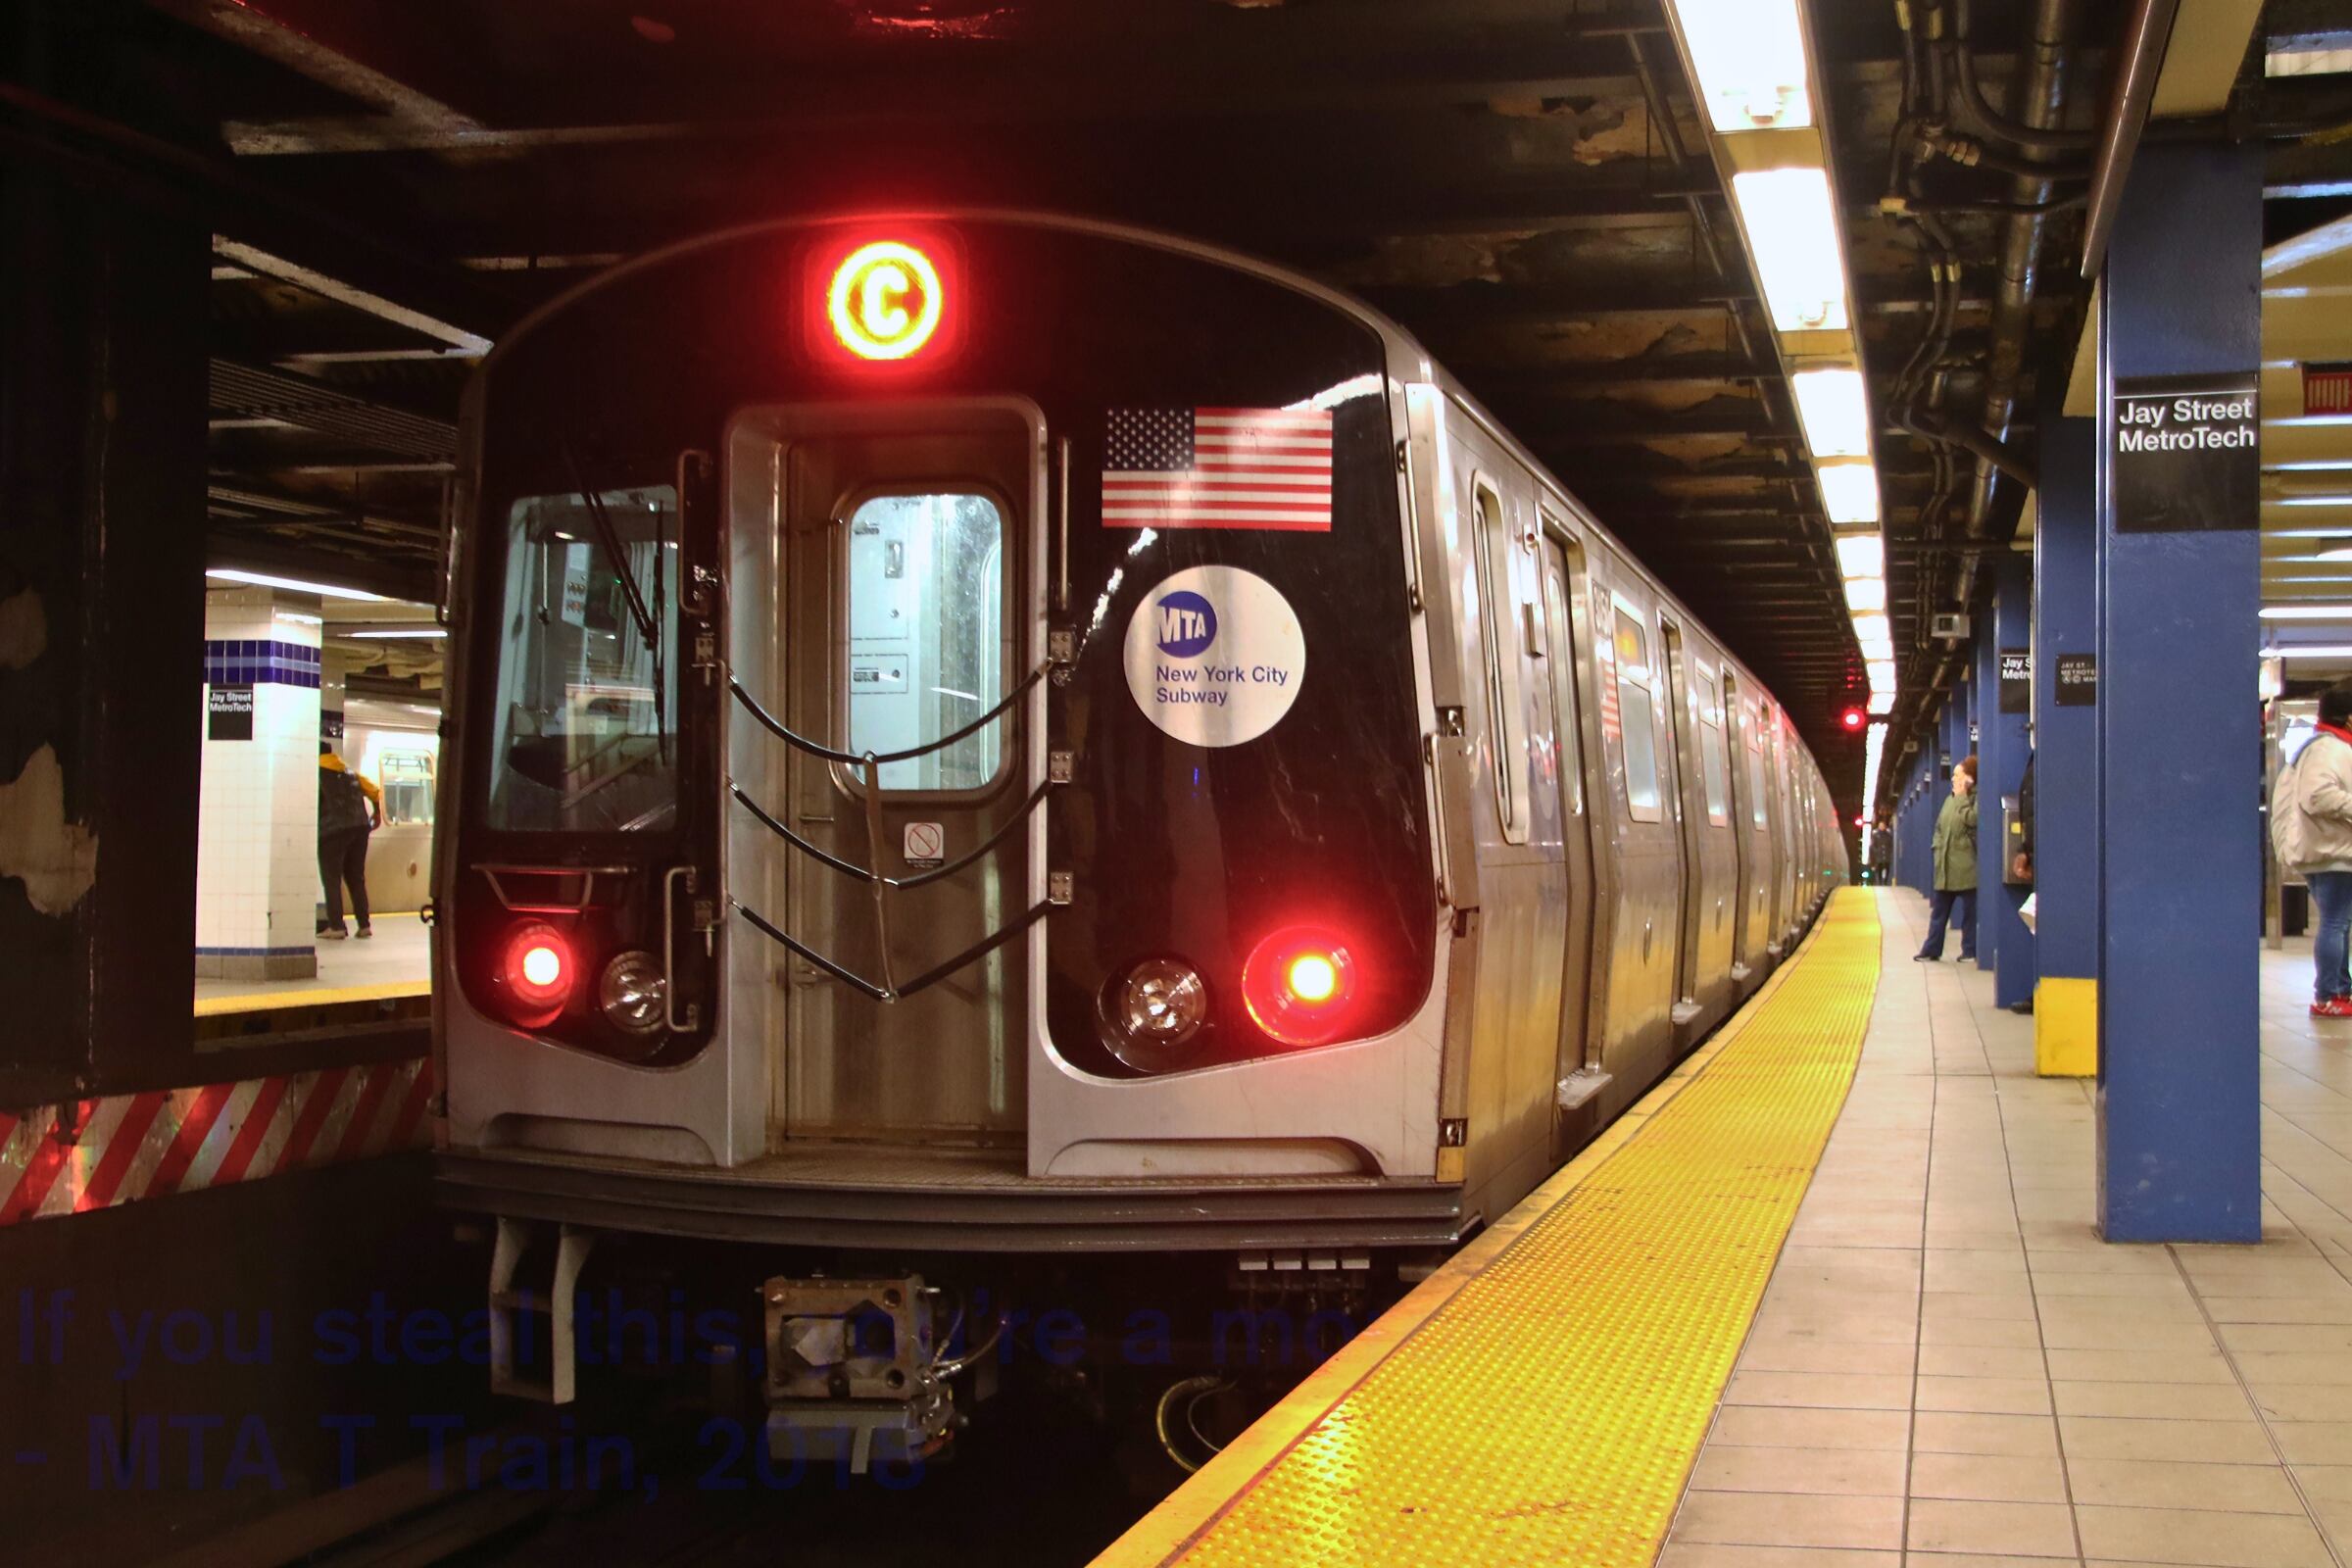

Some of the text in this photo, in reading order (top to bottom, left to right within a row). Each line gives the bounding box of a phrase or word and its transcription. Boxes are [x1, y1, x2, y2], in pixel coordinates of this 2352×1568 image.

[862, 265, 910, 336] C
[2119, 398, 2253, 428] Jay Street
[2119, 424, 2255, 452] MetroTech
[1156, 605, 1207, 644] MTA
[1156, 665, 1288, 686] New York City
[2002, 658, 2023, 669] Jay
[1155, 687, 1228, 707] Subway
